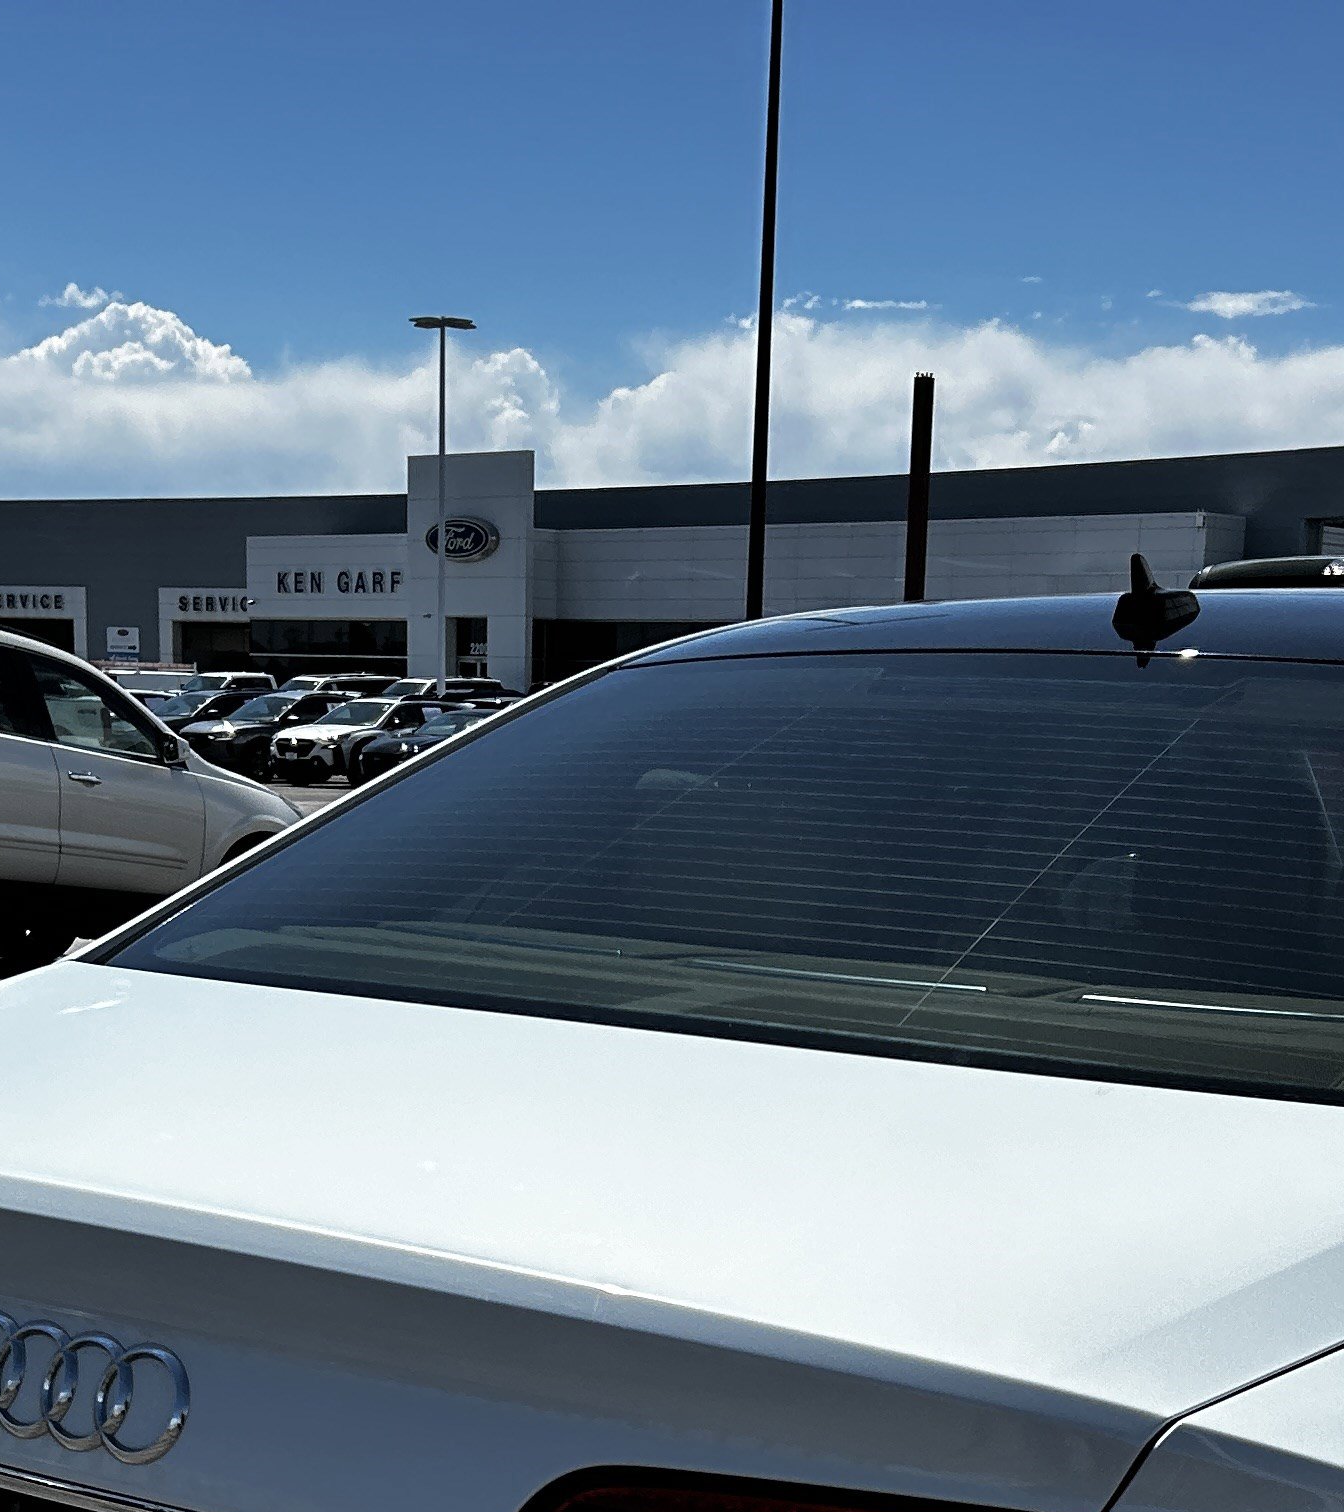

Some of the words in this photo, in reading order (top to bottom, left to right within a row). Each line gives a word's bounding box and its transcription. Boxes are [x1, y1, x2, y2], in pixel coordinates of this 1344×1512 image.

[445, 526, 475, 550] Ford
[277, 571, 323, 593] KEN
[178, 595, 248, 612] SERVIC
